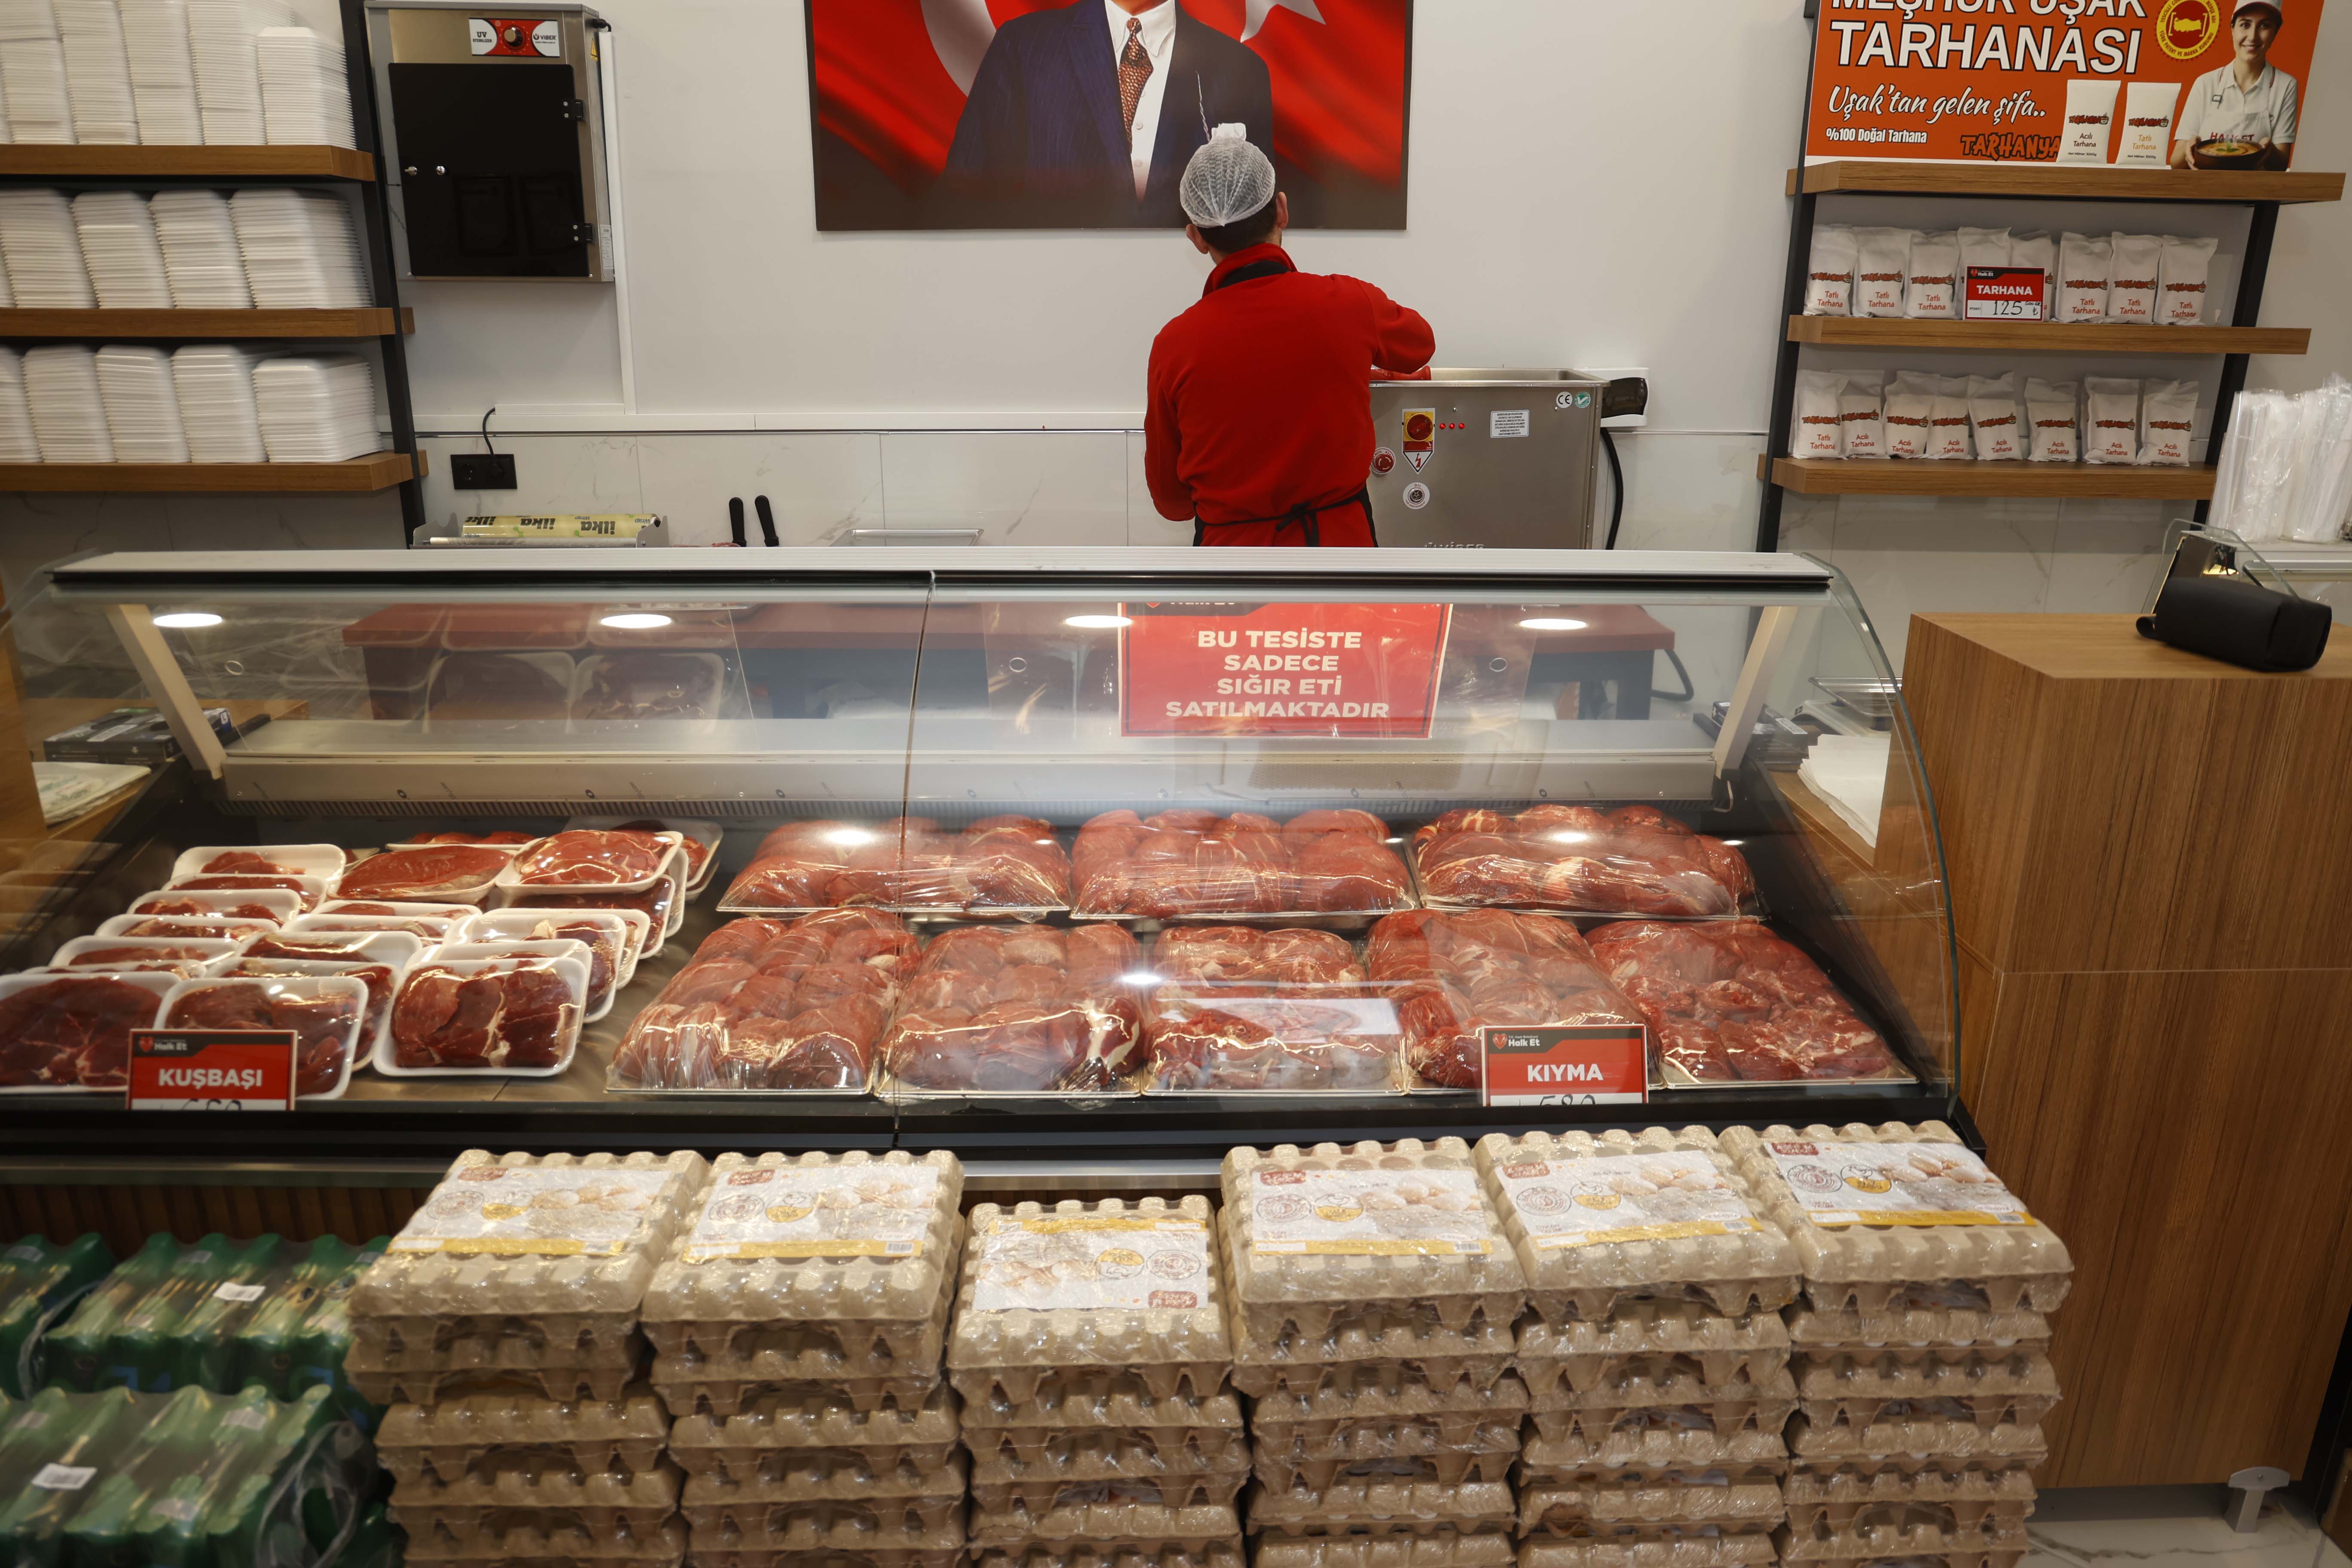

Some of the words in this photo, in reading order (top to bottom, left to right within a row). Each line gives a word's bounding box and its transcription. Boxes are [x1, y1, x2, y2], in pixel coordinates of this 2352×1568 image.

[1830, 20, 2142, 74] TARHANASI
[2164, 43, 2177, 54] PATENT
[1828, 84, 1926, 121] Uşak'tan
[1926, 86, 1991, 124] gelen
[1993, 90, 2046, 126] şifa..
[1826, 127, 1856, 141] %100
[1858, 128, 1886, 144] Doğal
[1888, 129, 1928, 144] Tarhana
[1825, 291, 1838, 299] Tatlı
[1976, 285, 2033, 295] TARHANA
[1817, 299, 1843, 308] Tarhana
[1993, 300, 2023, 315] 125
[1558, 394, 1570, 404] CE
[1892, 446, 1914, 454] Tarhana
[2158, 450, 2181, 458] Tarhana
[521, 518, 556, 530] ilka
[581, 520, 616, 535] ilka
[1198, 631, 1237, 648] BU
[1246, 627, 1363, 649] TESİSTE
[1224, 655, 1339, 671] SADECE
[1217, 674, 1291, 695] SIĞIR
[1299, 675, 1342, 695] ETİ
[1166, 701, 1389, 718] SATILMAKTADIR
[154, 1042, 174, 1050] Halk
[176, 1042, 187, 1050] Et
[1508, 1038, 1528, 1047] Halk
[1530, 1038, 1540, 1047] Et
[158, 1068, 263, 1090] KUŞBAŞI
[1527, 1063, 1604, 1082] KIYMA
